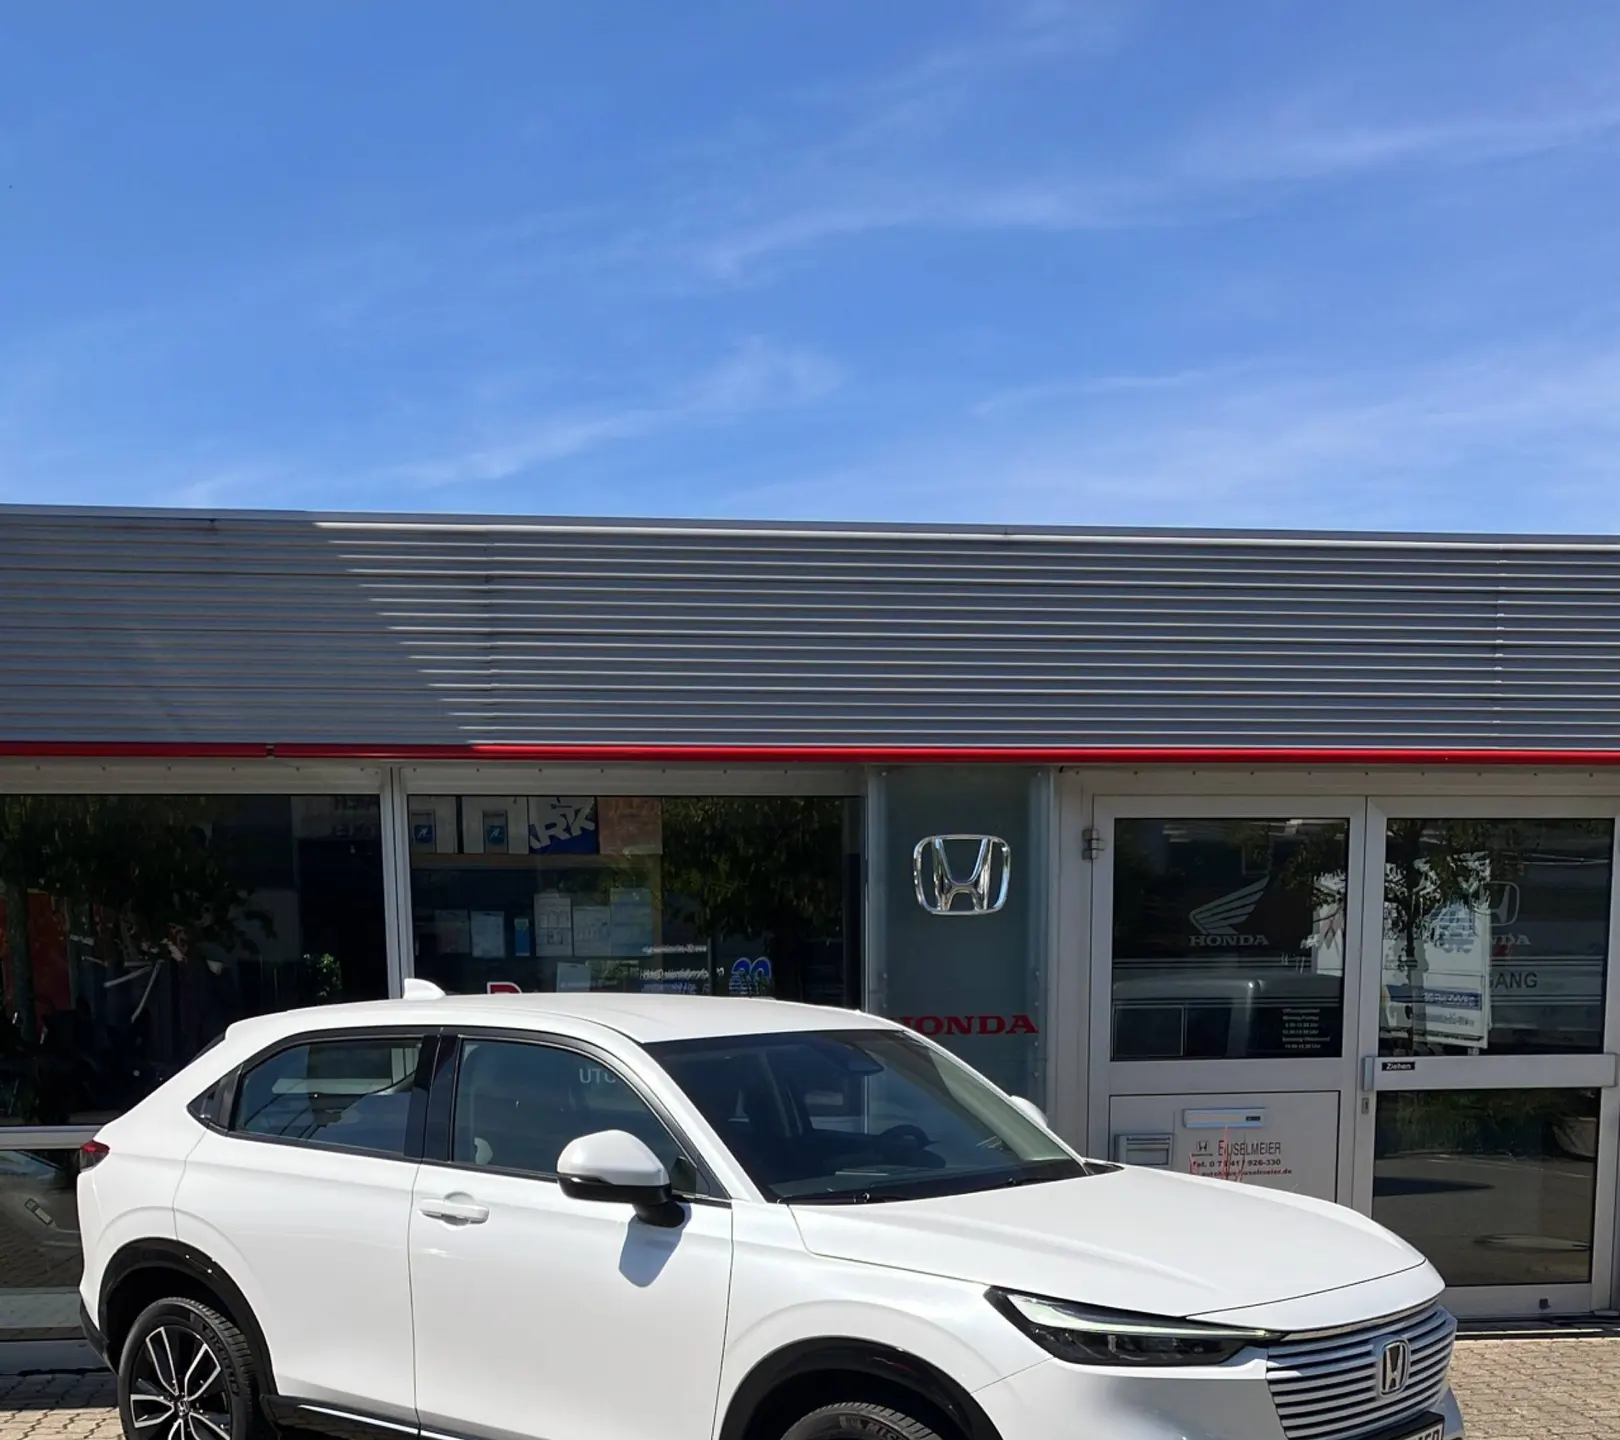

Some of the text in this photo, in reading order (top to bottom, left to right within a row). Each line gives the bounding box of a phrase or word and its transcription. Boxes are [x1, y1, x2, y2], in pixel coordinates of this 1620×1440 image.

[1188, 934, 1269, 947] HONDA
[1489, 971, 1538, 990] ANG
[1192, 1160, 1207, 1168] Tel.
[1247, 1159, 1281, 1167] 926-330
